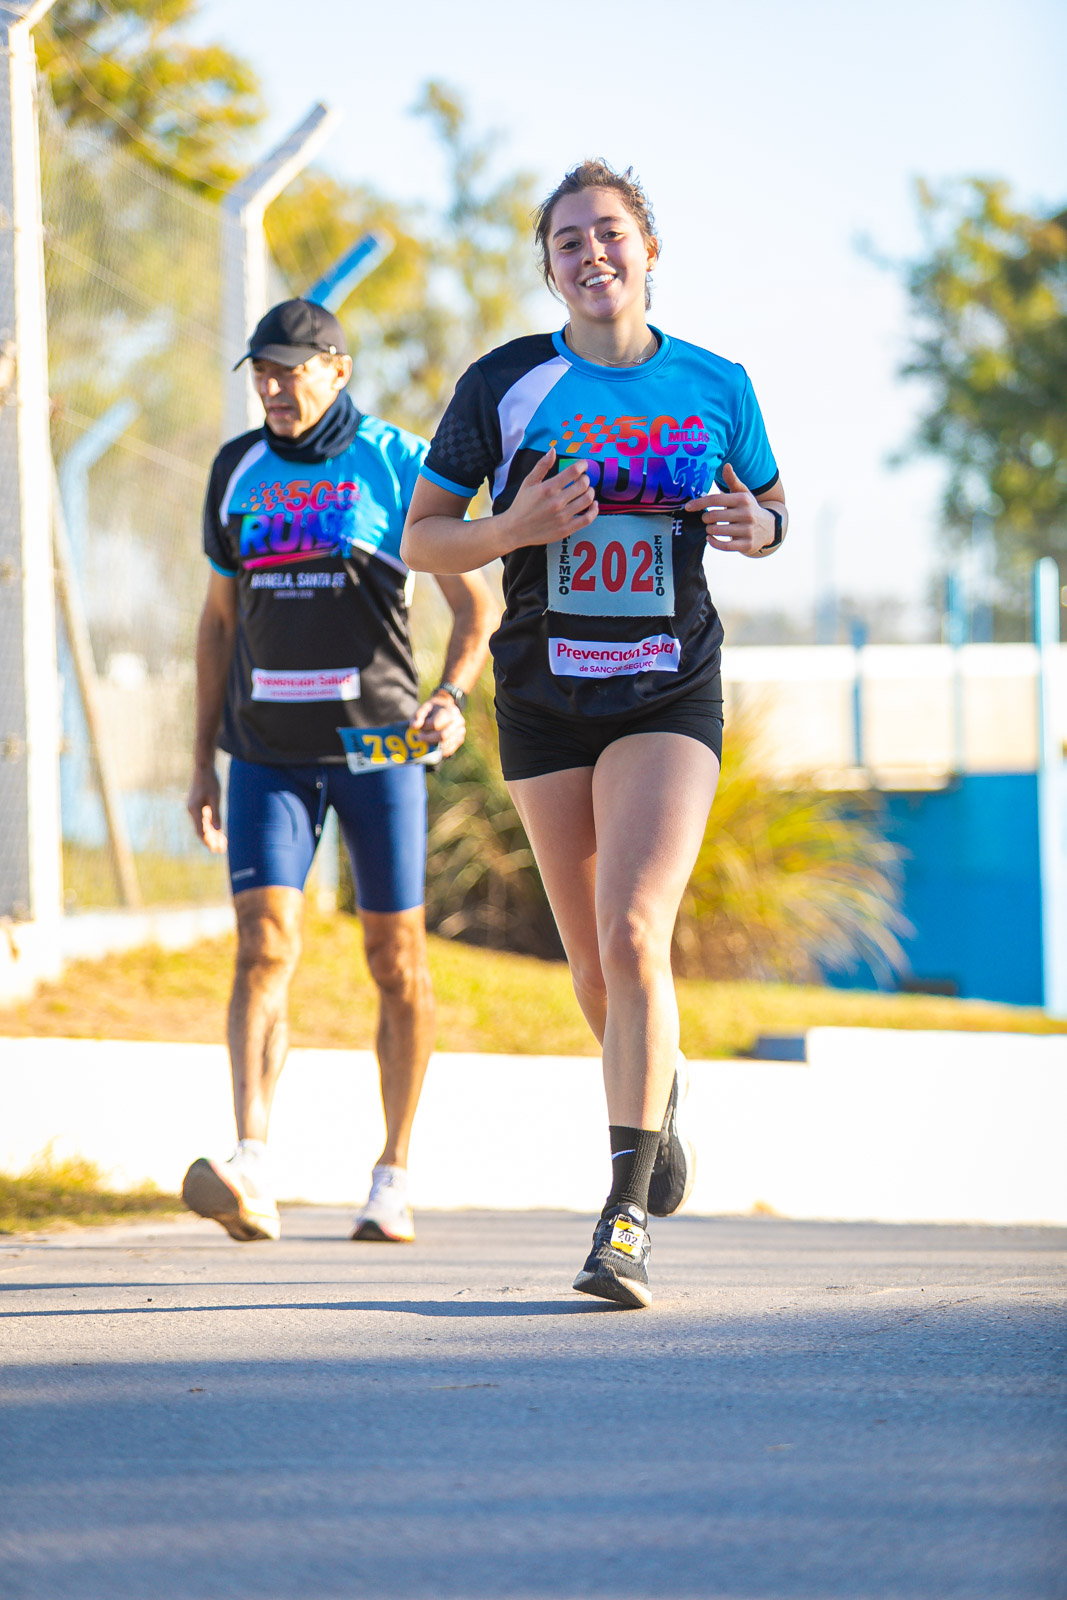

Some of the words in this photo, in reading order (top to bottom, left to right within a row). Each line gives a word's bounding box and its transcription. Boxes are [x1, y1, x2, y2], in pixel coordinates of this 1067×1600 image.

[615, 414, 708, 457] 500
[668, 430, 711, 443] MILLAS
[558, 535, 571, 596] TIEMPO
[570, 540, 655, 593] 202
[653, 535, 665, 597] EXACTO
[589, 665, 623, 674] SANCOR
[617, 1230, 639, 1246] 202
